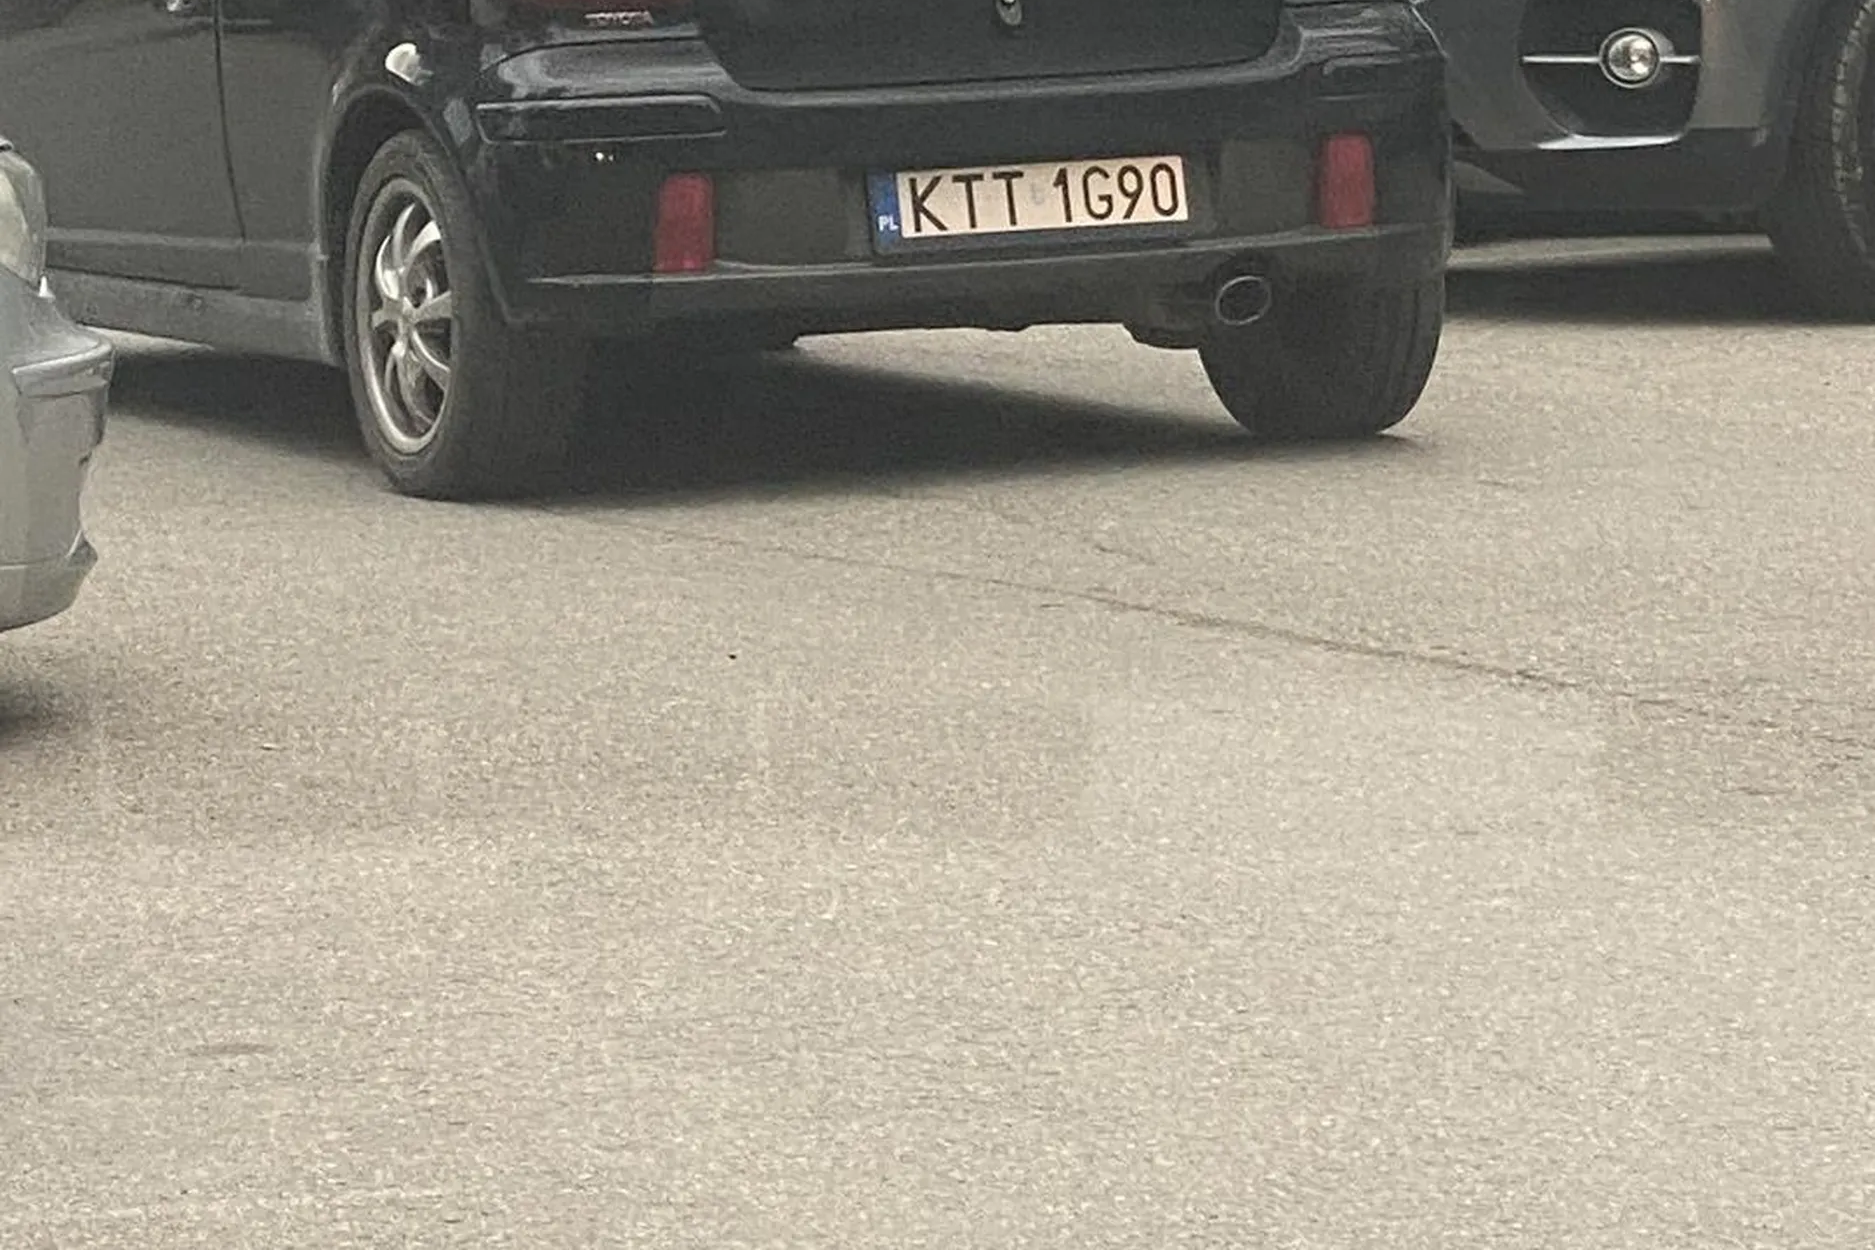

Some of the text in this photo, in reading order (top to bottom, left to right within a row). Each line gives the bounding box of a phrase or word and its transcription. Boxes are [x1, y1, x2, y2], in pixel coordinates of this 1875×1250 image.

[908, 162, 1179, 233] KTT 1G90
[878, 214, 899, 232] PL
